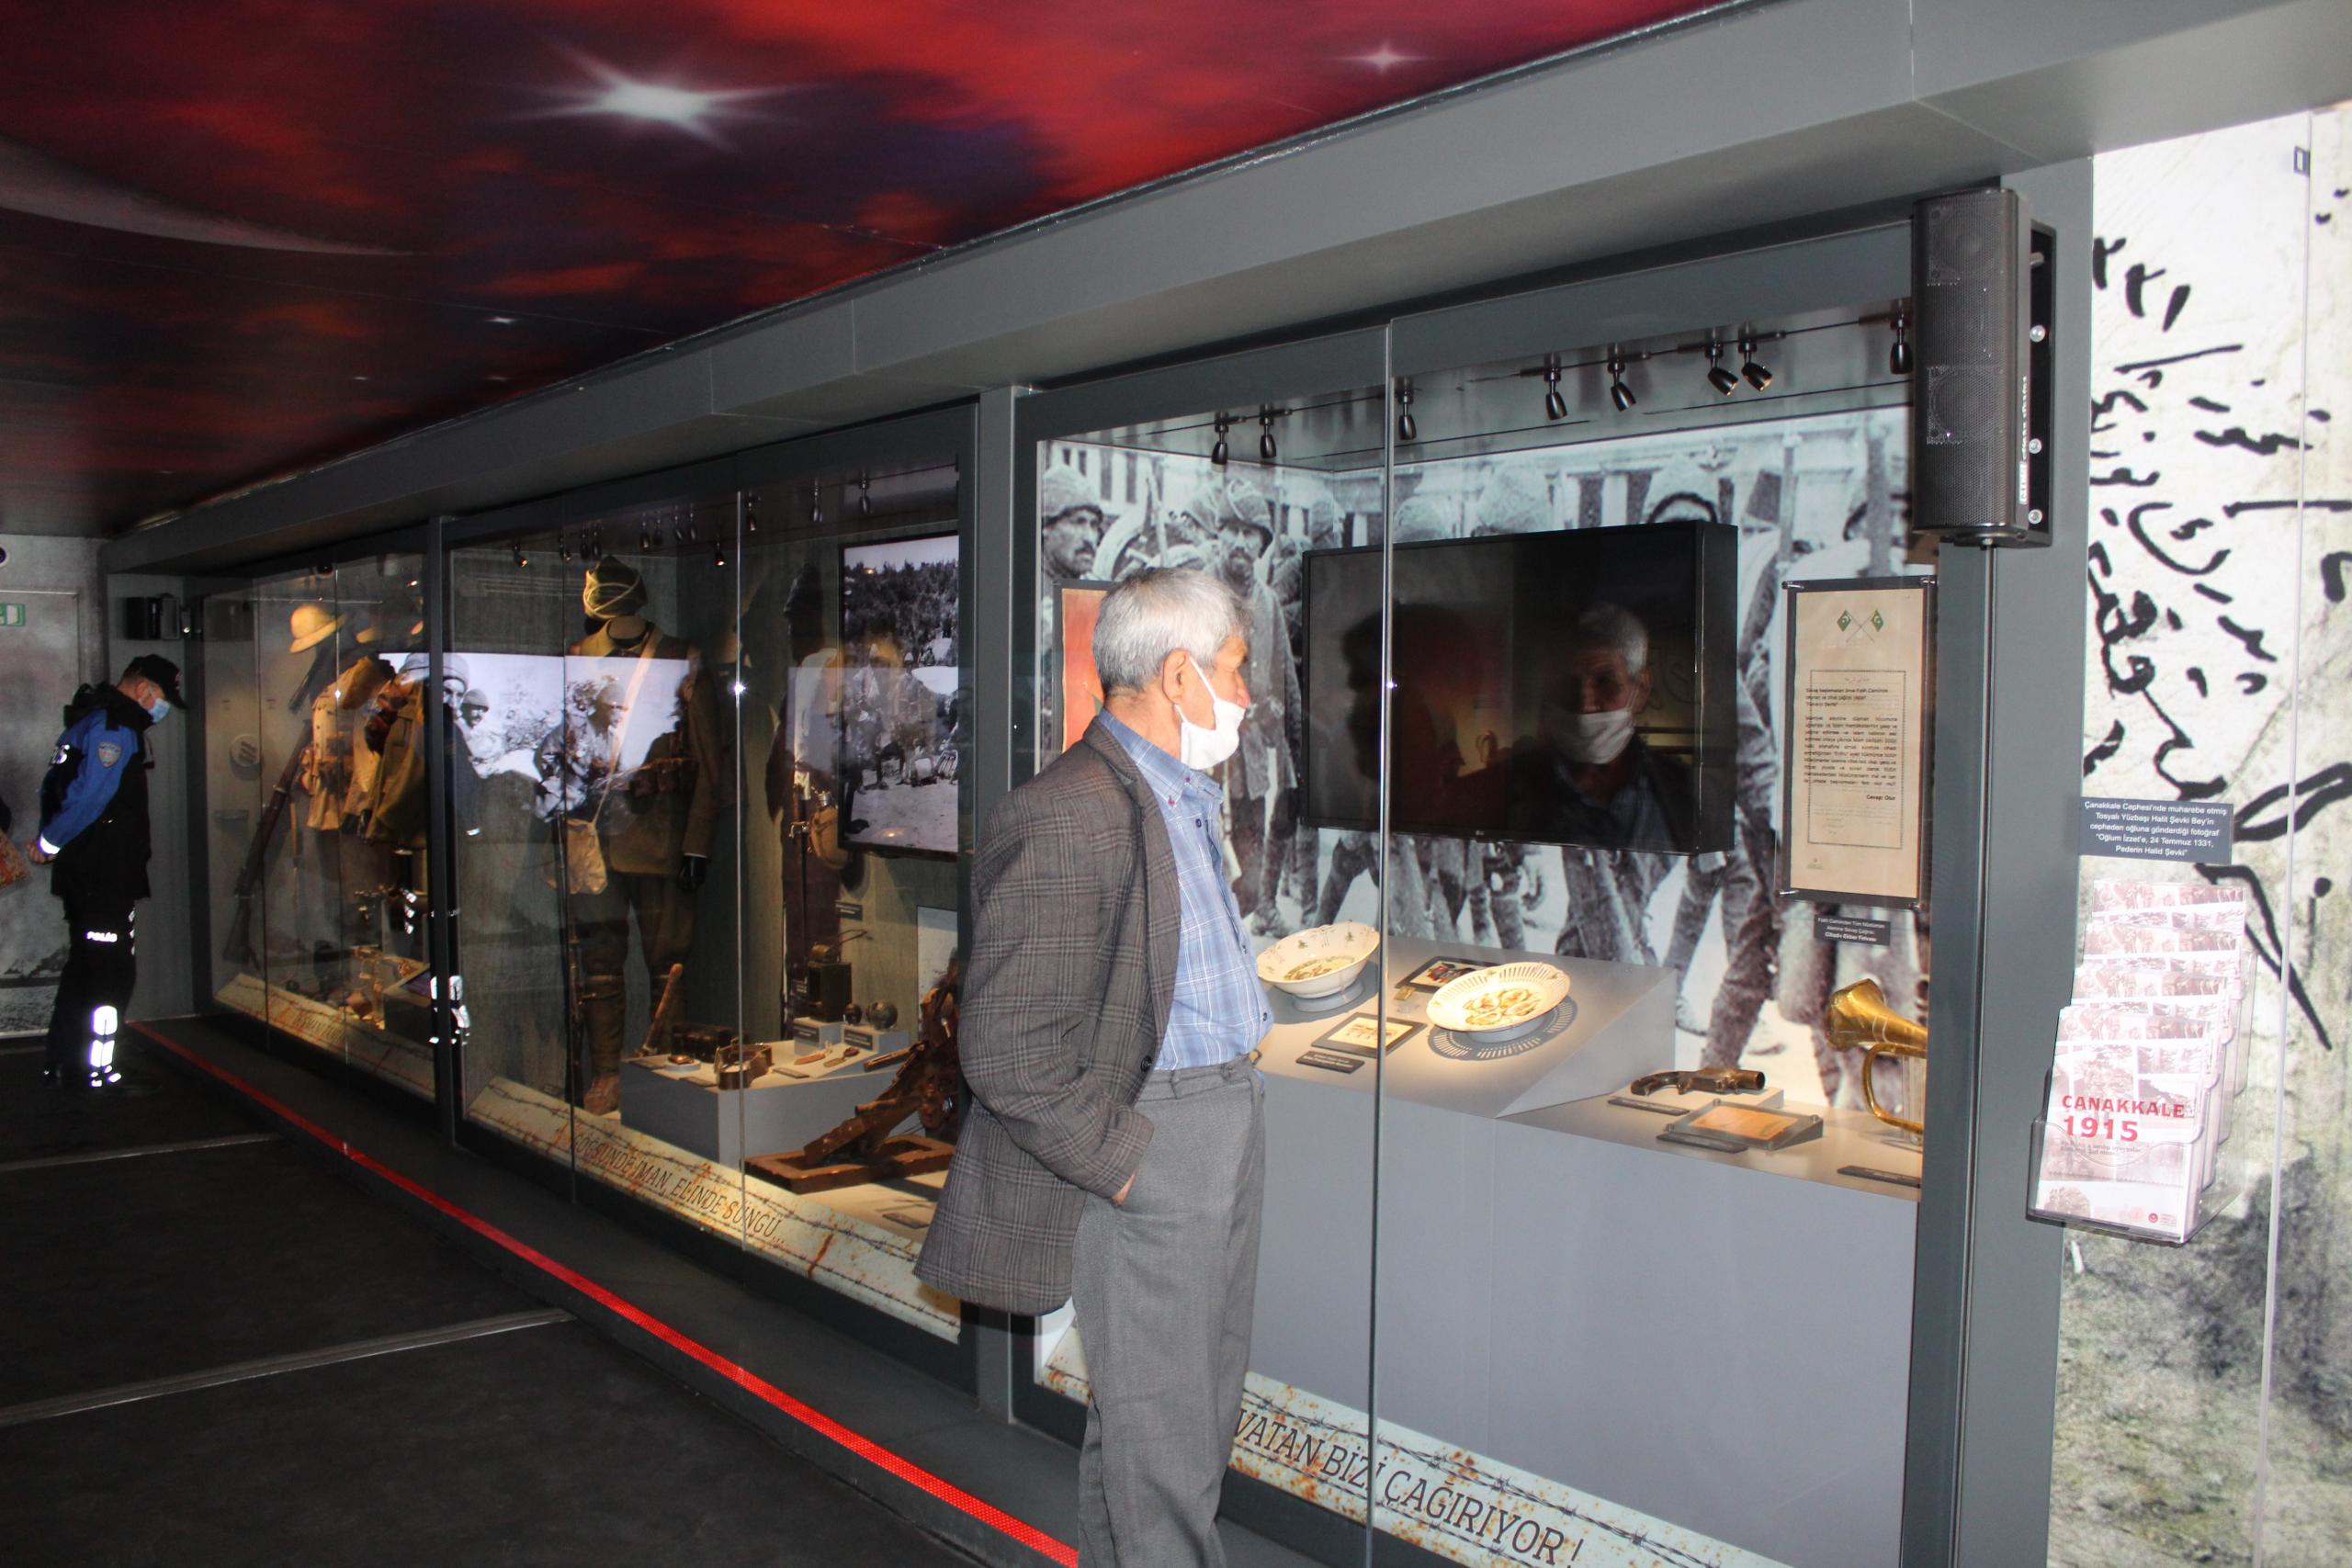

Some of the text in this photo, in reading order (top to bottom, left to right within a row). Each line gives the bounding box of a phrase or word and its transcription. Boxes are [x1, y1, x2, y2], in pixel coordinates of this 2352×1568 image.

[2084, 801, 2227, 816] Çanakkale Cephesi'nde muharebe etmiş
[2096, 812, 2119, 821] Tosyalı
[2120, 813, 2150, 822] Yüzbaşı
[2191, 818, 2213, 826] Bey'in
[2090, 823, 2220, 837] cepheden oğluna gönderdiği fotoğraf
[2161, 838, 2191, 846] Temmuz
[2115, 845, 2143, 853] Pederin
[2144, 847, 2163, 855] Halid
[2064, 1115, 2139, 1142] 1915
[1235, 1408, 1326, 1467] VATAN
